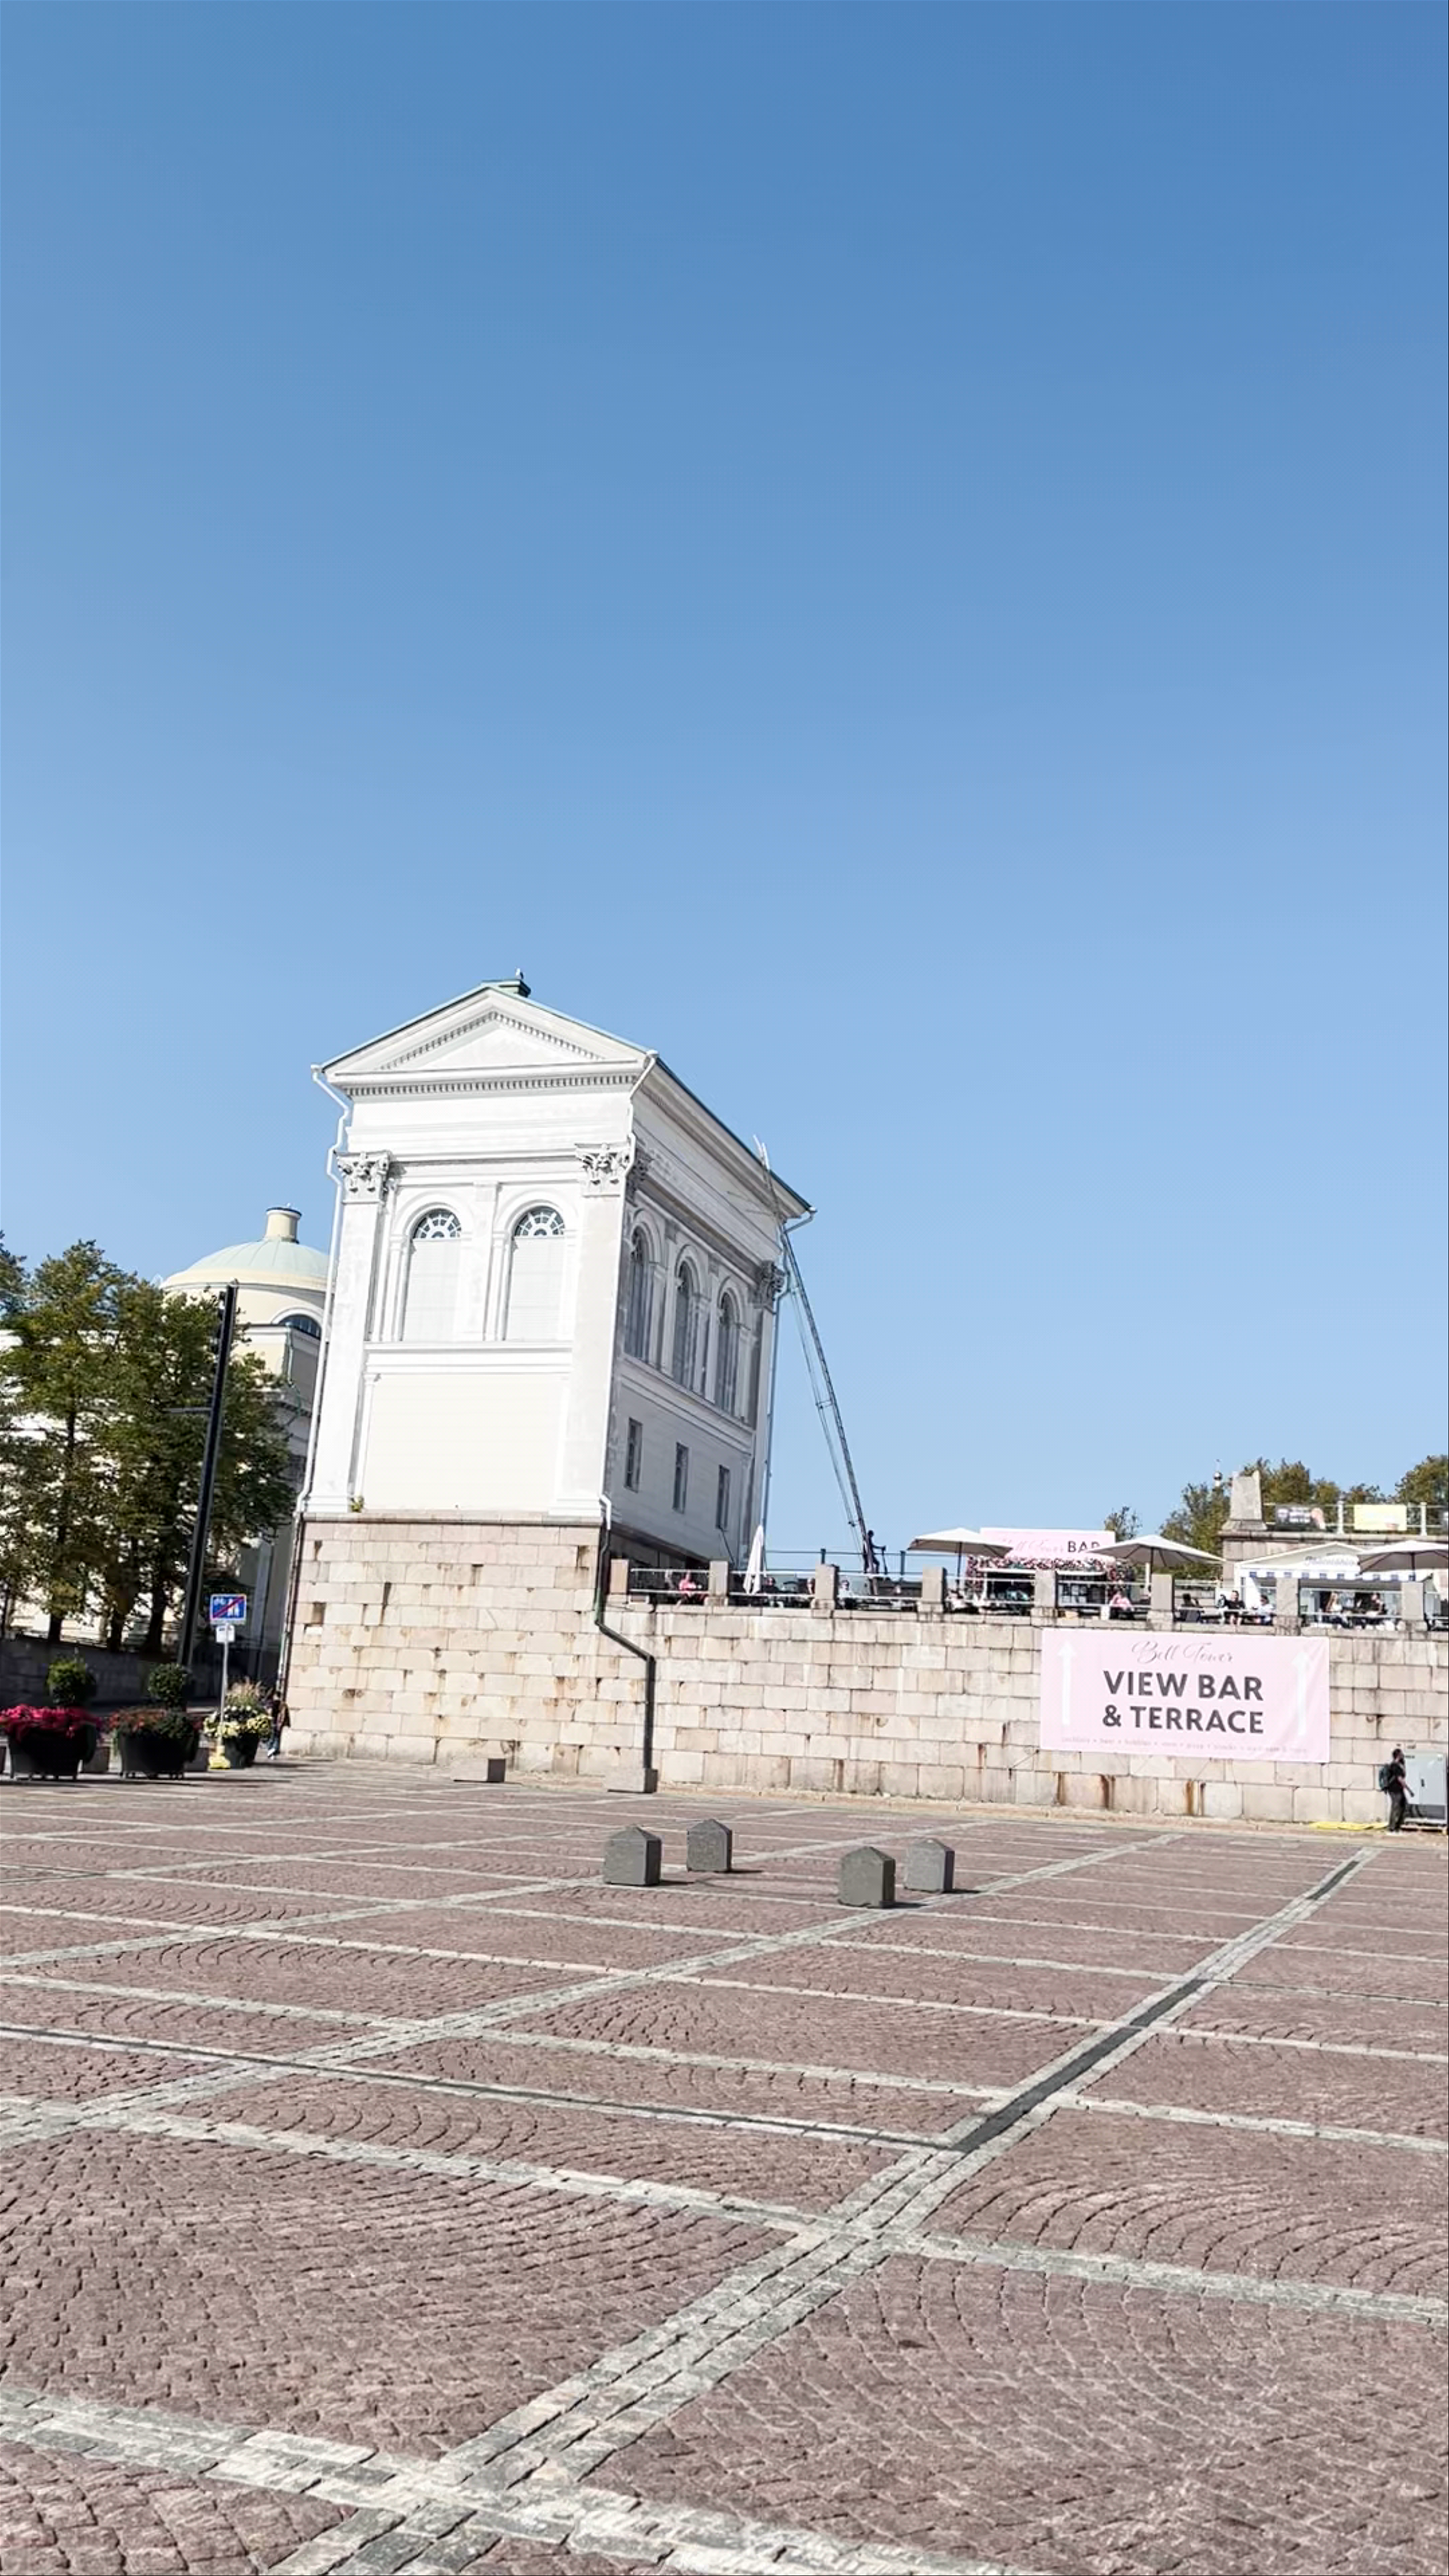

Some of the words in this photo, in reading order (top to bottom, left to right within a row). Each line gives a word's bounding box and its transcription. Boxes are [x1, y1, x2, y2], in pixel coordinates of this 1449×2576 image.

[1131, 1641, 1180, 1664] Bell
[1182, 1642, 1233, 1663] Tower
[1103, 1670, 1188, 1697] VIEW
[1198, 1674, 1264, 1701] BAR
[1102, 1704, 1121, 1727] &
[1130, 1706, 1264, 1734] TERRACE
